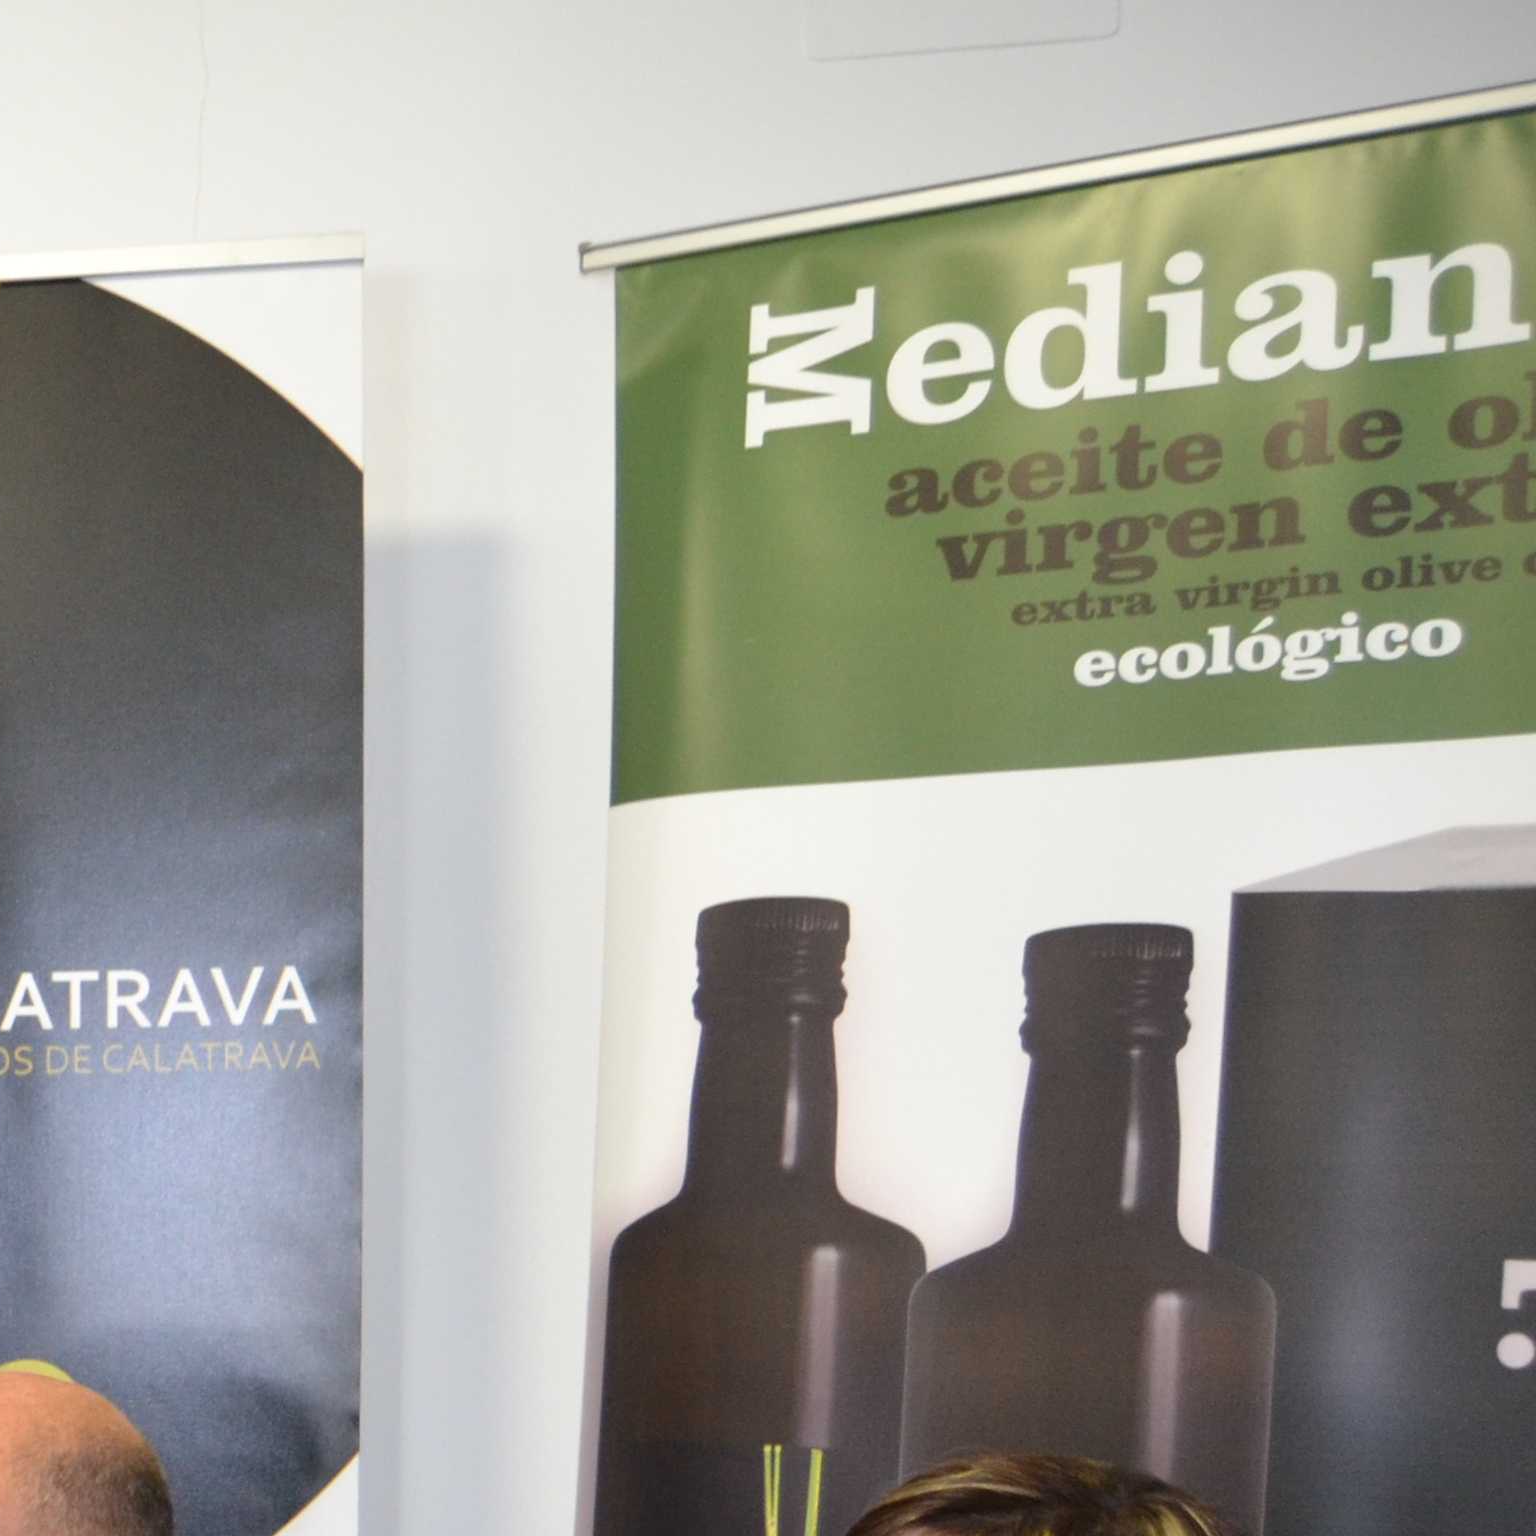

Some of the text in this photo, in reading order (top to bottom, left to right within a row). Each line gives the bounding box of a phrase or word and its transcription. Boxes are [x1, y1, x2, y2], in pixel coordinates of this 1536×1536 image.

[744, 241, 1533, 450] Median
[884, 421, 1223, 518] aceite
[1263, 397, 1403, 472] de
[936, 495, 1305, 586] virgen
[1011, 587, 1157, 628] extra
[1174, 566, 1342, 614] virgin
[1361, 554, 1503, 592] olive
[1073, 612, 1463, 688] ecológico
[45, 1044, 93, 1076] DE
[103, 1041, 322, 1075] CALATRAVA
